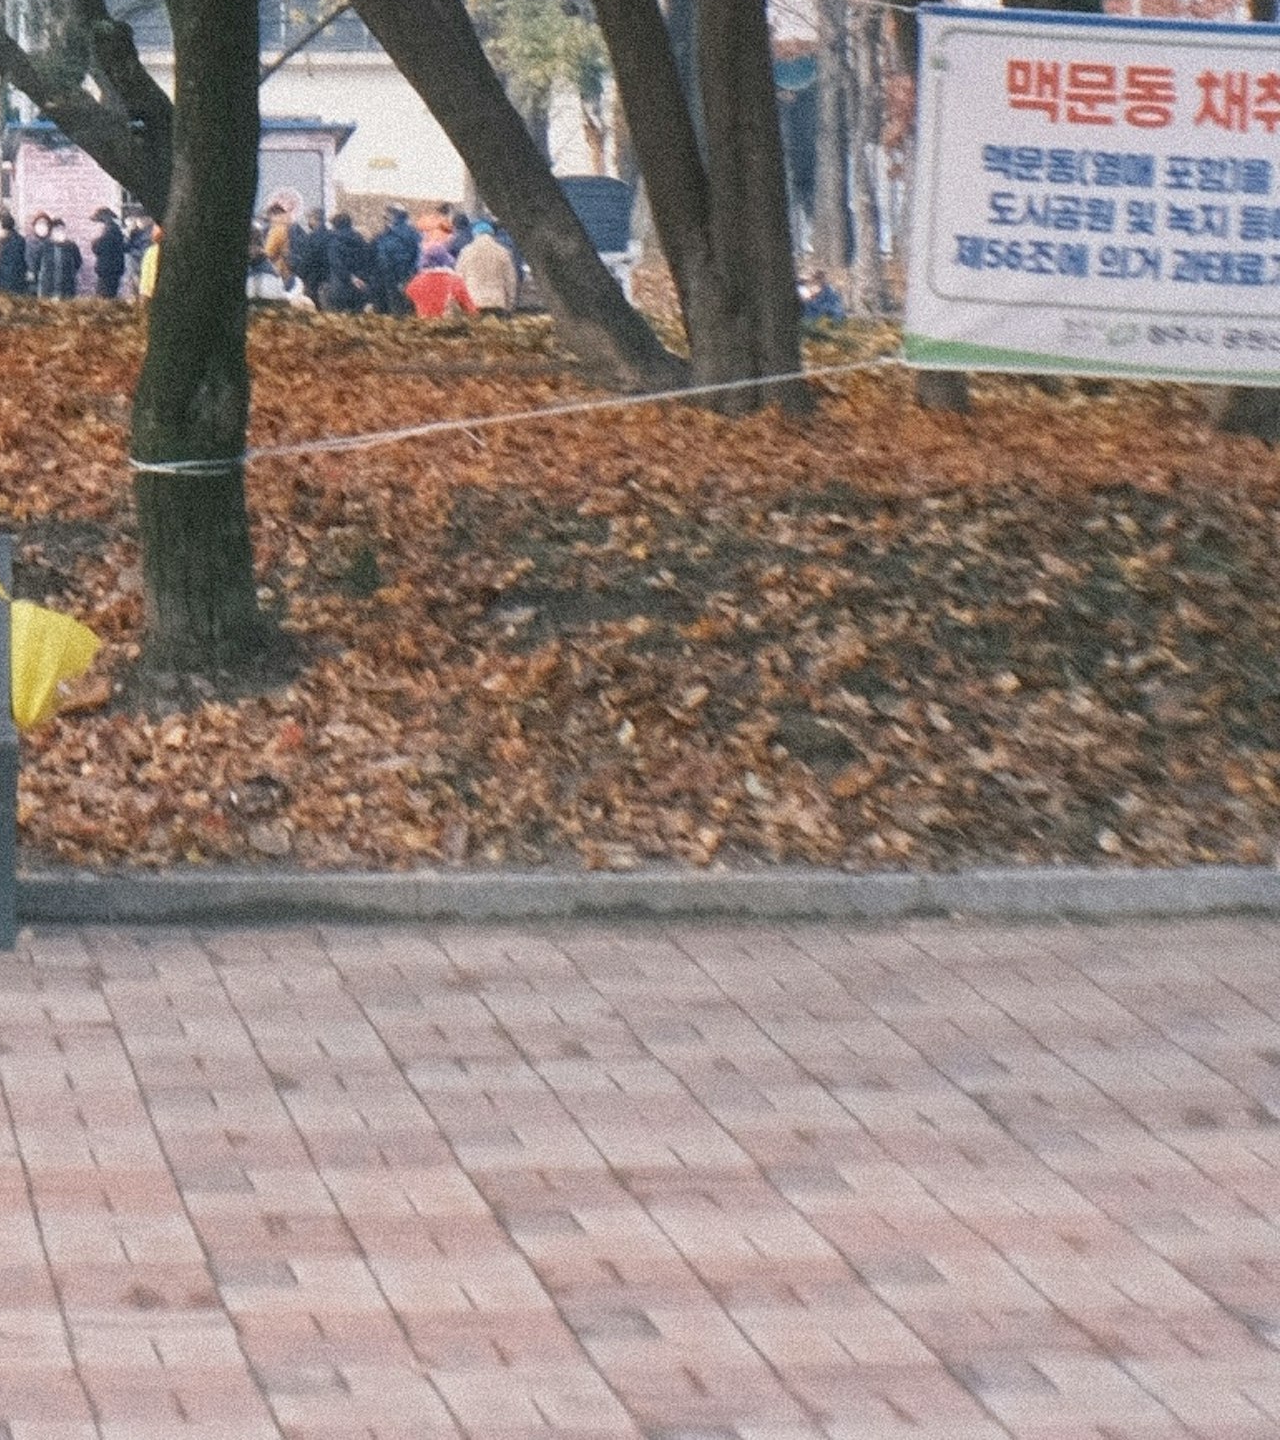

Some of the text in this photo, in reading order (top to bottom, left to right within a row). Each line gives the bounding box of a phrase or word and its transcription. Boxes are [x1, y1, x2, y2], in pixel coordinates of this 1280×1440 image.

[1006, 57, 1176, 128] 맥문동
[987, 190, 1116, 233] 도시공원
[1124, 198, 1156, 236] 및
[1167, 203, 1230, 239] 녹지
[1096, 244, 1162, 282] 의거
